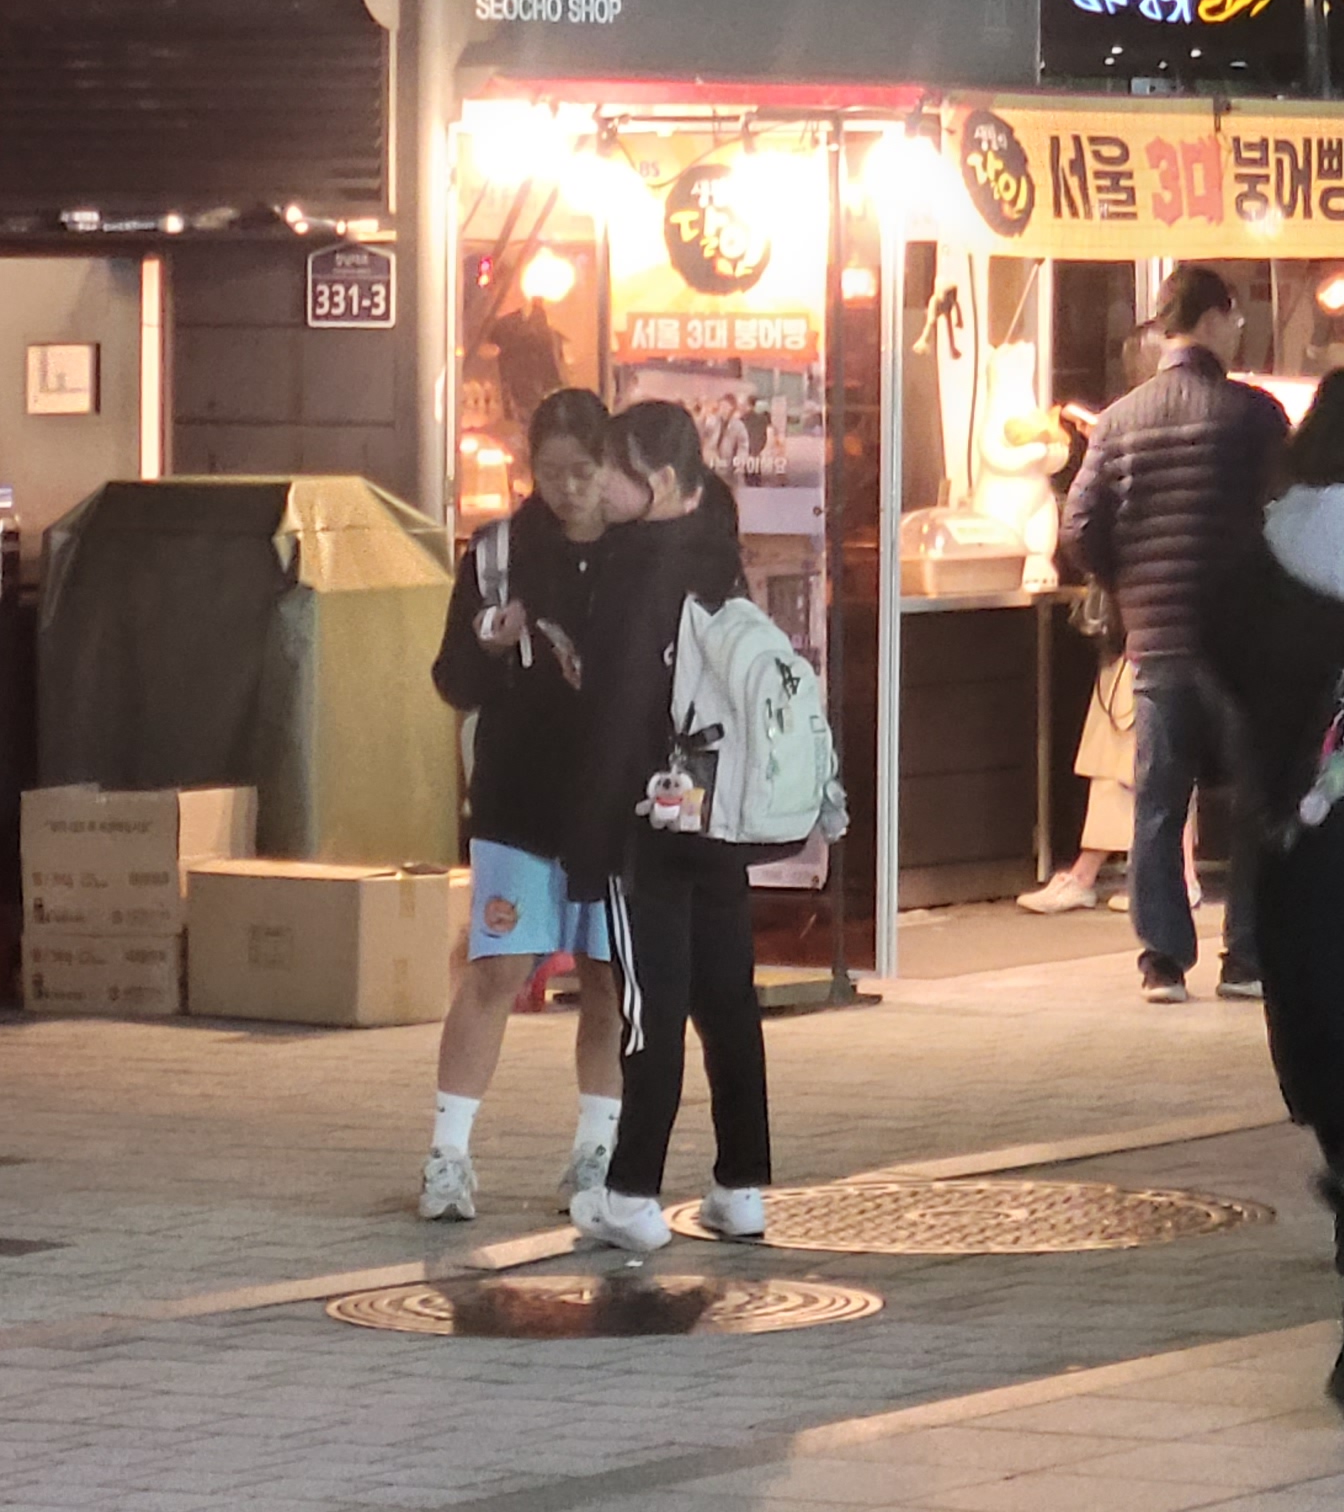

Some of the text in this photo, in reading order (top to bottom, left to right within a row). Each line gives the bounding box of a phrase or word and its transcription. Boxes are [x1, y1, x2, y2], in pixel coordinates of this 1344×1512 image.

[1050, 133, 1138, 221] 서울
[1145, 133, 1224, 226] 3대
[315, 283, 387, 316] 331-3
[631, 317, 807, 350] 서울 3대 붕어빵
